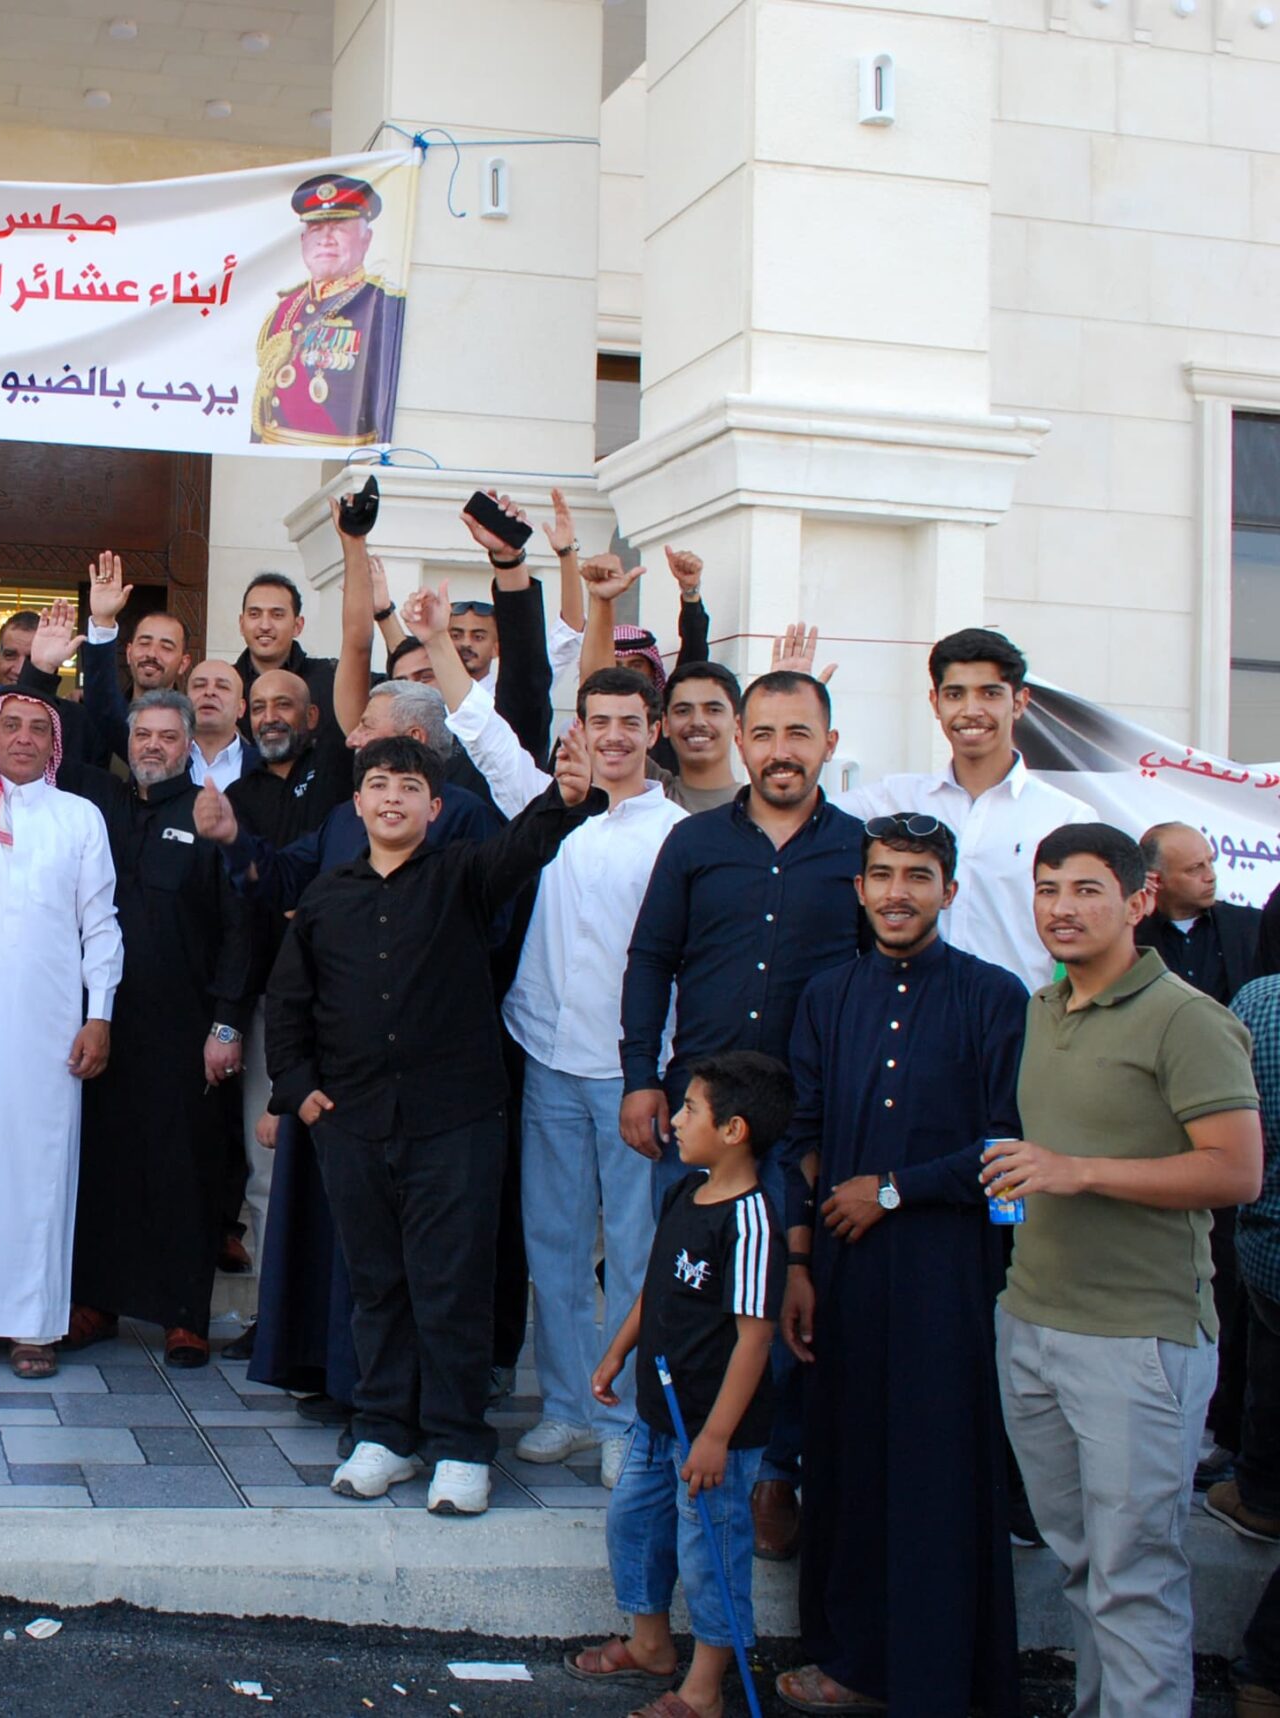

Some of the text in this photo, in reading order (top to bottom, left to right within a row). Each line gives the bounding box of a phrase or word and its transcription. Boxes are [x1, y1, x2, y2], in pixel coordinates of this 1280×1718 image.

[10, 262, 139, 311] عشائر
[150, 254, 239, 317] أبناء
[135, 378, 239, 416] يرحب
